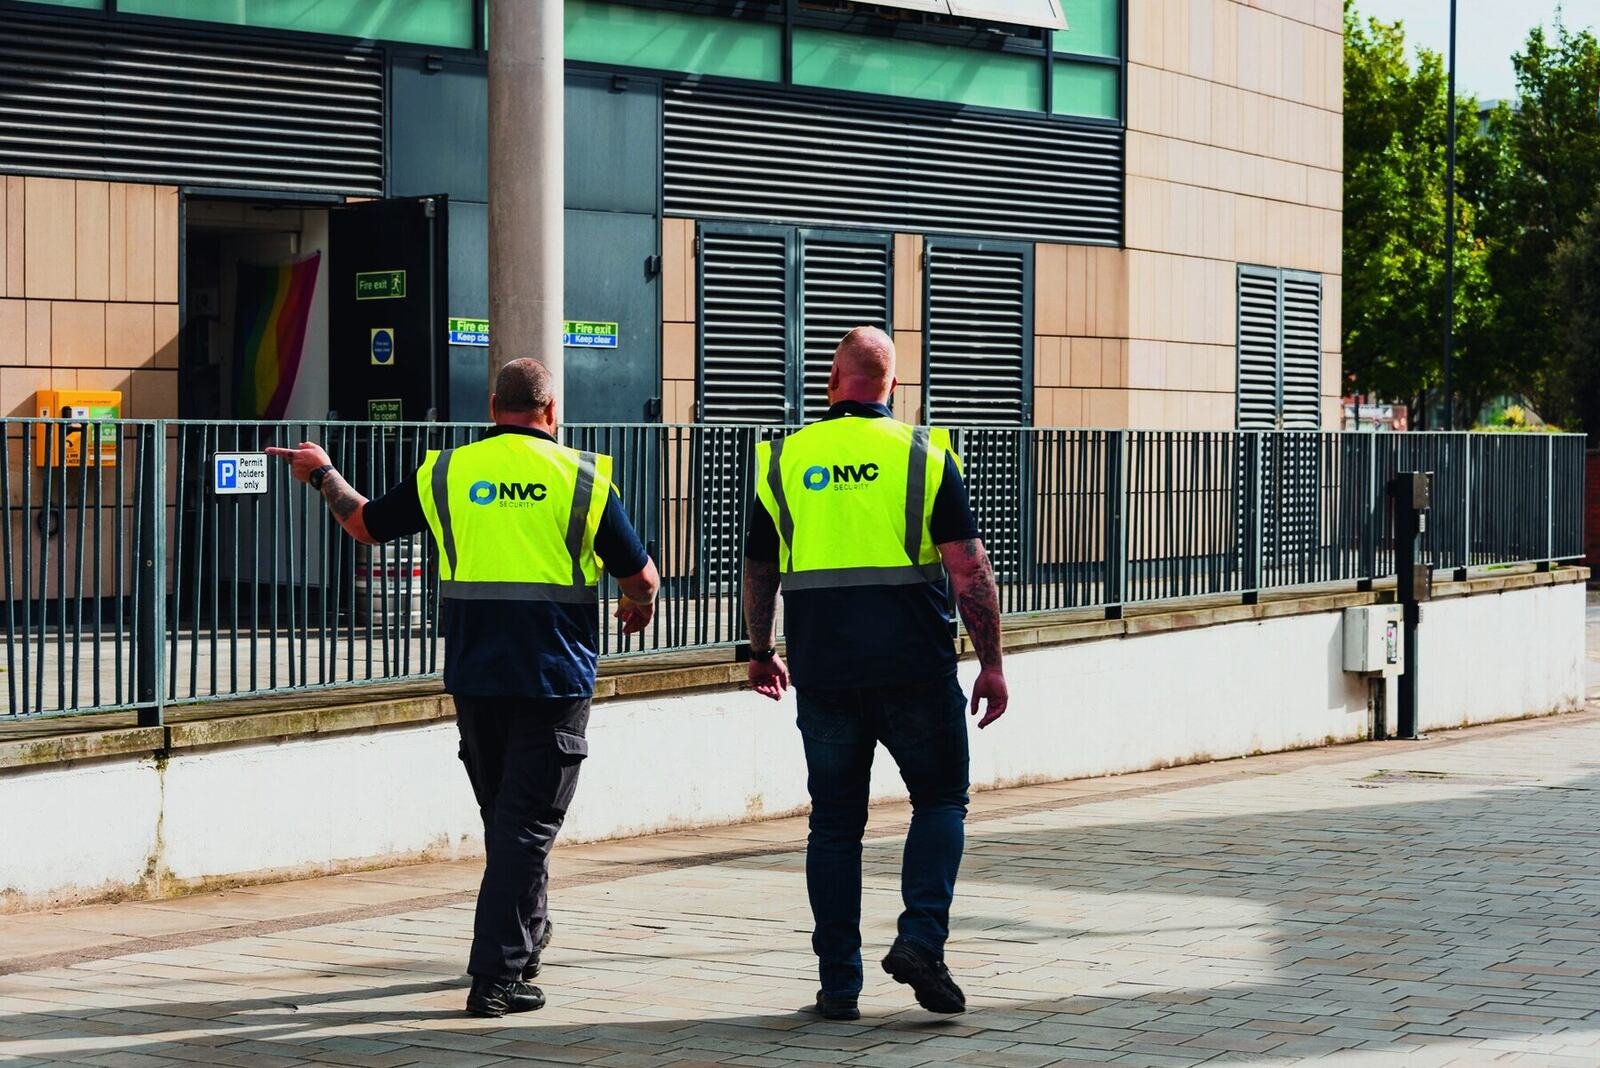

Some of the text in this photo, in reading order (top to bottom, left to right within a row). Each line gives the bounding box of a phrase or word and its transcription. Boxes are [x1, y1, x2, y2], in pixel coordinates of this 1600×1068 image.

[360, 279, 387, 290] Fire exit
[457, 321, 489, 333] Fire ex
[575, 323, 611, 335] Fire exit
[457, 333, 476, 343] Keep
[575, 335, 611, 345] Keep clear
[240, 457, 263, 467] Permit
[222, 463, 235, 486] P
[238, 470, 265, 478] holders
[833, 463, 880, 483] NVC
[243, 480, 260, 490] only
[833, 483, 870, 491] SECURITY
[499, 482, 548, 502] NVC
